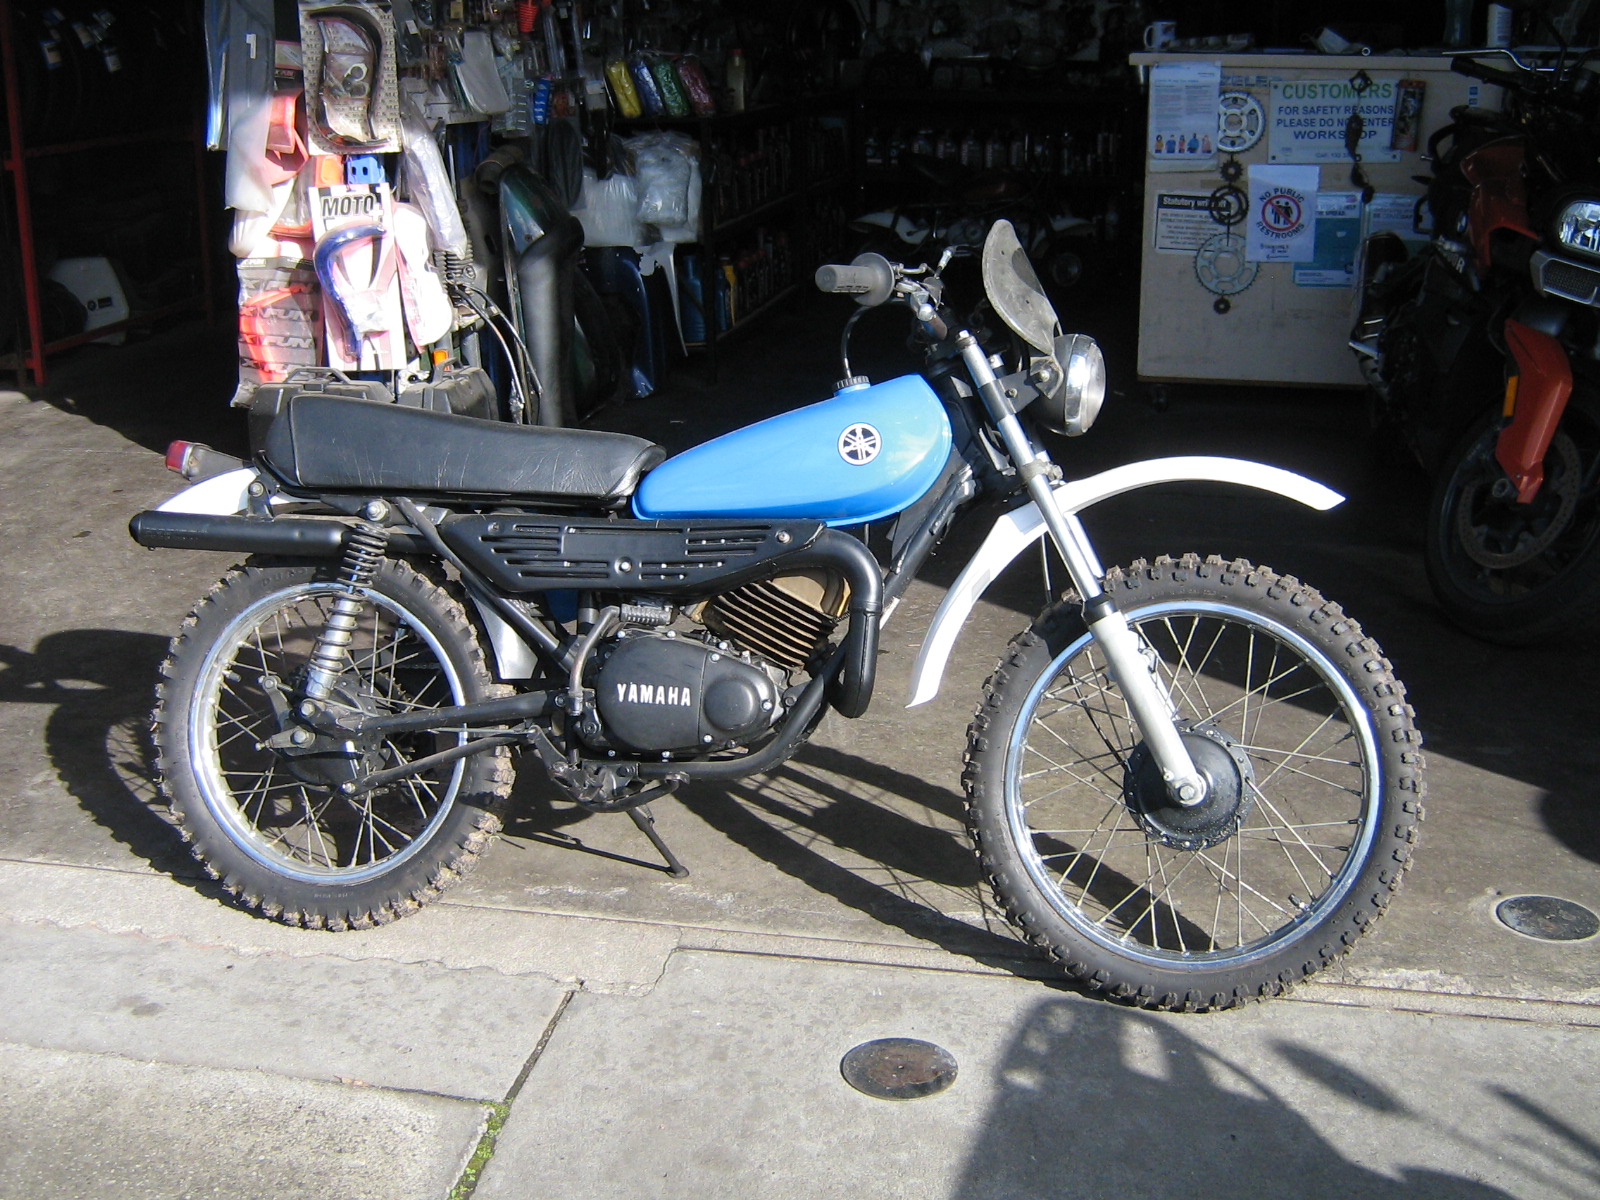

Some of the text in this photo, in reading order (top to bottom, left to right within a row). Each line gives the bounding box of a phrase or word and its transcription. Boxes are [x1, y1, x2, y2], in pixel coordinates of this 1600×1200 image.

[1278, 105, 1394, 115] FOR SAFETY REASONS
[1276, 118, 1316, 127] PLEASE
[1319, 117, 1334, 127] DO
[1293, 130, 1378, 140] WORKSOP
[1259, 187, 1305, 203] NO PUBLIC
[322, 194, 375, 217] MOTO
[1256, 220, 1305, 239] RESTROOMS
[617, 682, 691, 707] YAMAHA
